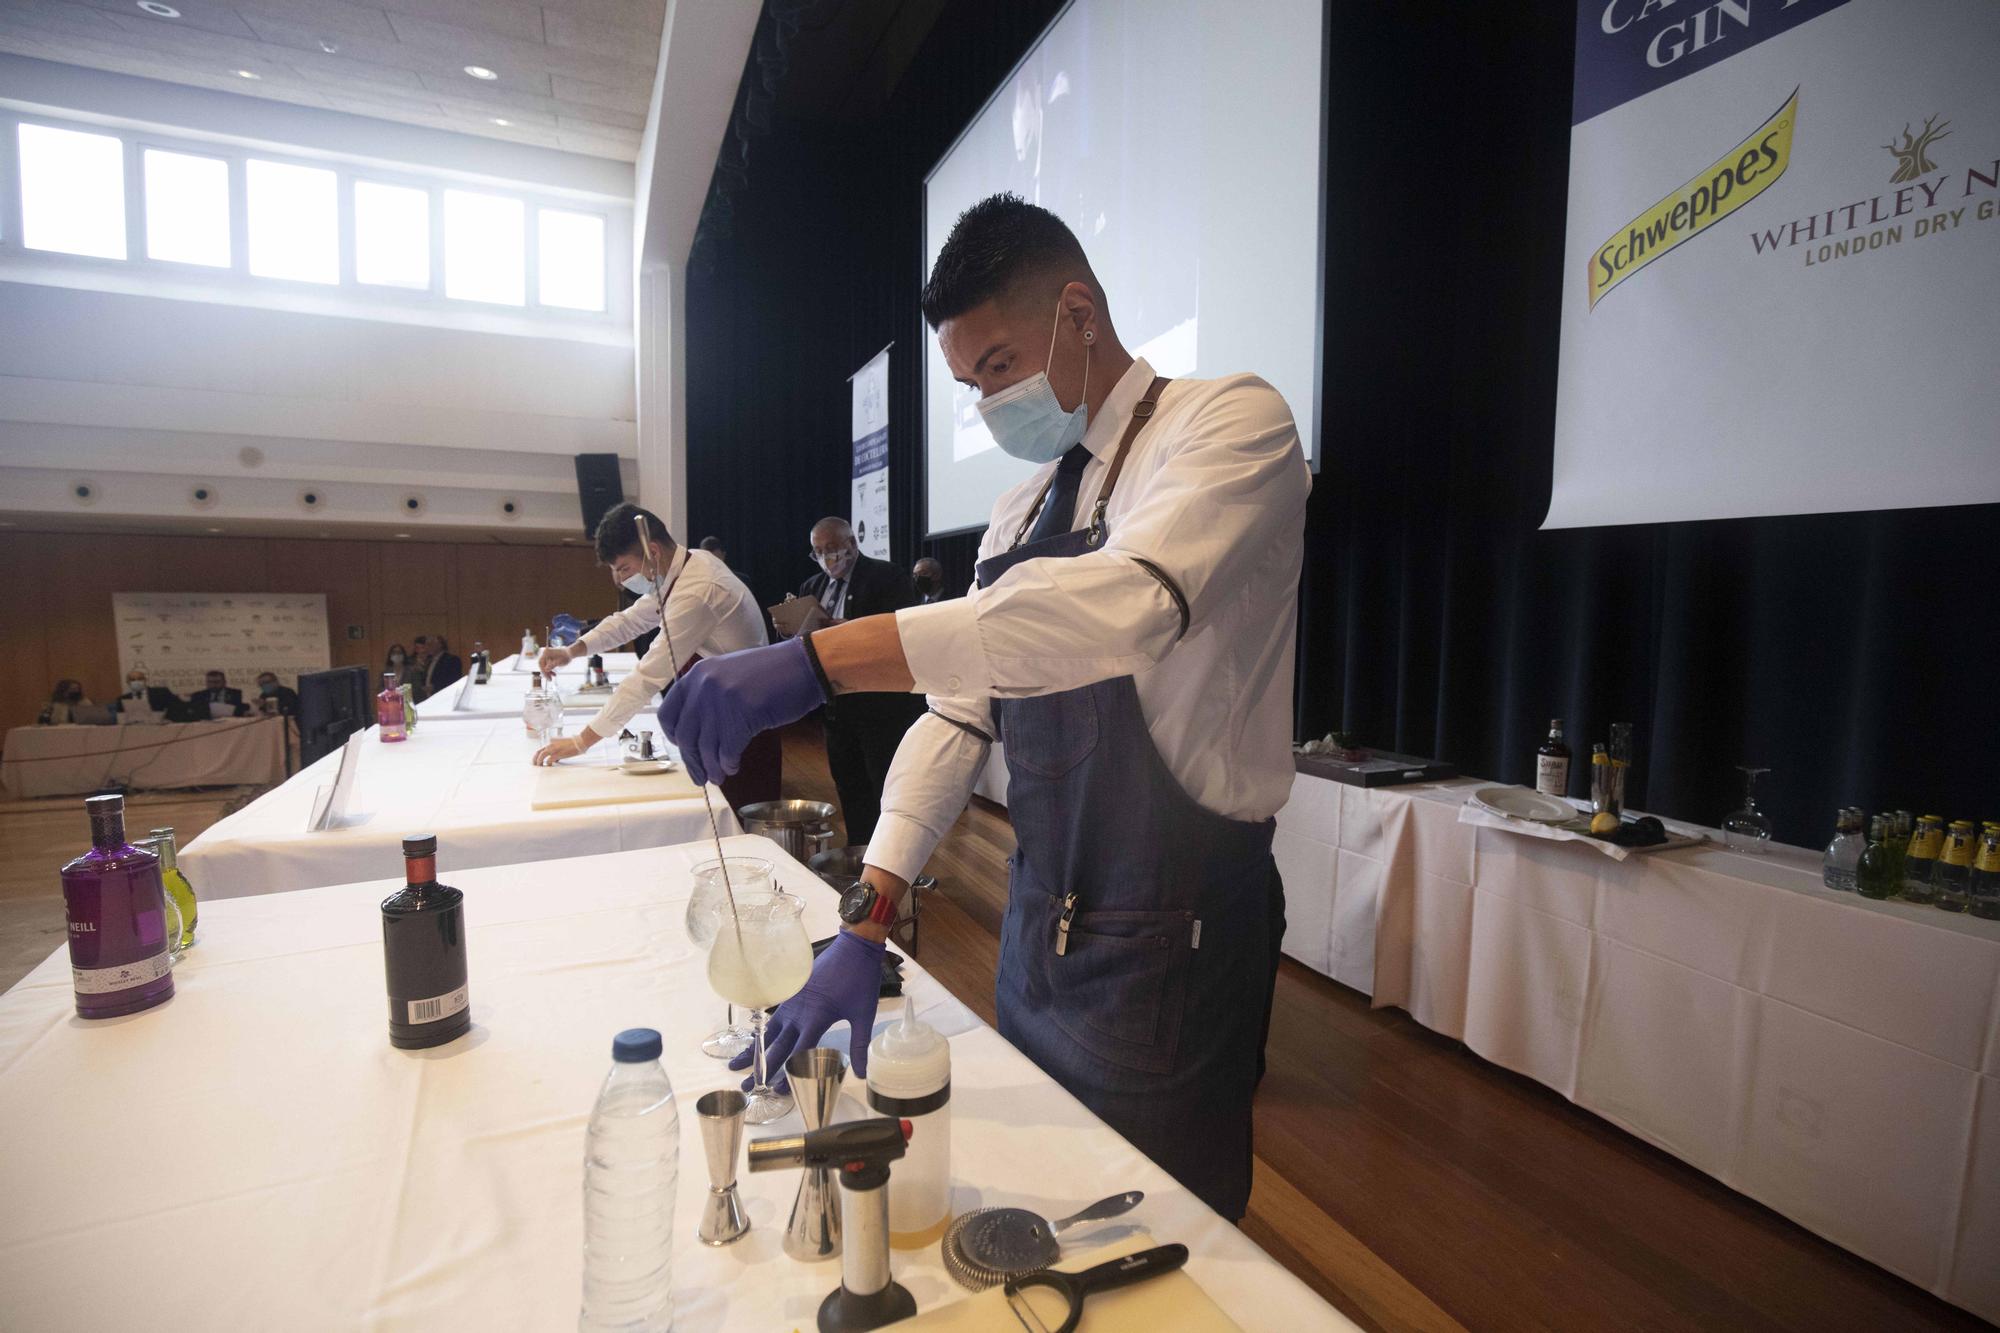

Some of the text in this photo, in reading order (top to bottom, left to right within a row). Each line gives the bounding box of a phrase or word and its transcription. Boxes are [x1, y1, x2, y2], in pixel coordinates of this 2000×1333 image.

[1646, 0, 1750, 68] GIN
[1598, 131, 1778, 287] Schweppes
[1750, 175, 1951, 255] WHITLEY
[1805, 225, 1903, 266] LONDON
[1914, 206, 1966, 238] DRY
[70, 922, 96, 932] NEILL
